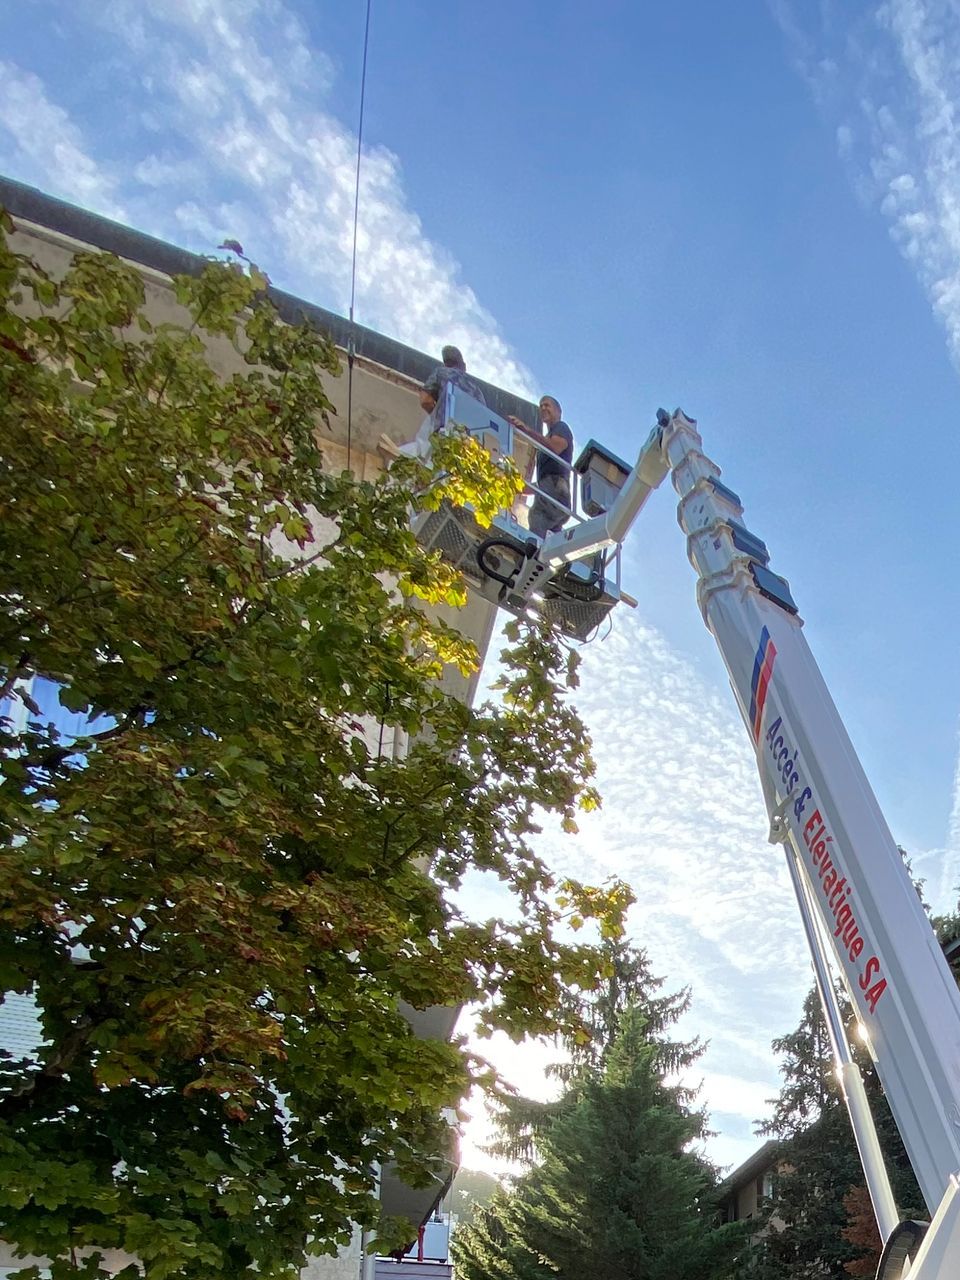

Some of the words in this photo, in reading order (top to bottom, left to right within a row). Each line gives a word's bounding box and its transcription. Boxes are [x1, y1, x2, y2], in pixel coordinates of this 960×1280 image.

[766, 715, 798, 795] Accès
[793, 786, 812, 822] &
[803, 809, 865, 963] Elévatique
[858, 956, 888, 1015] SA
